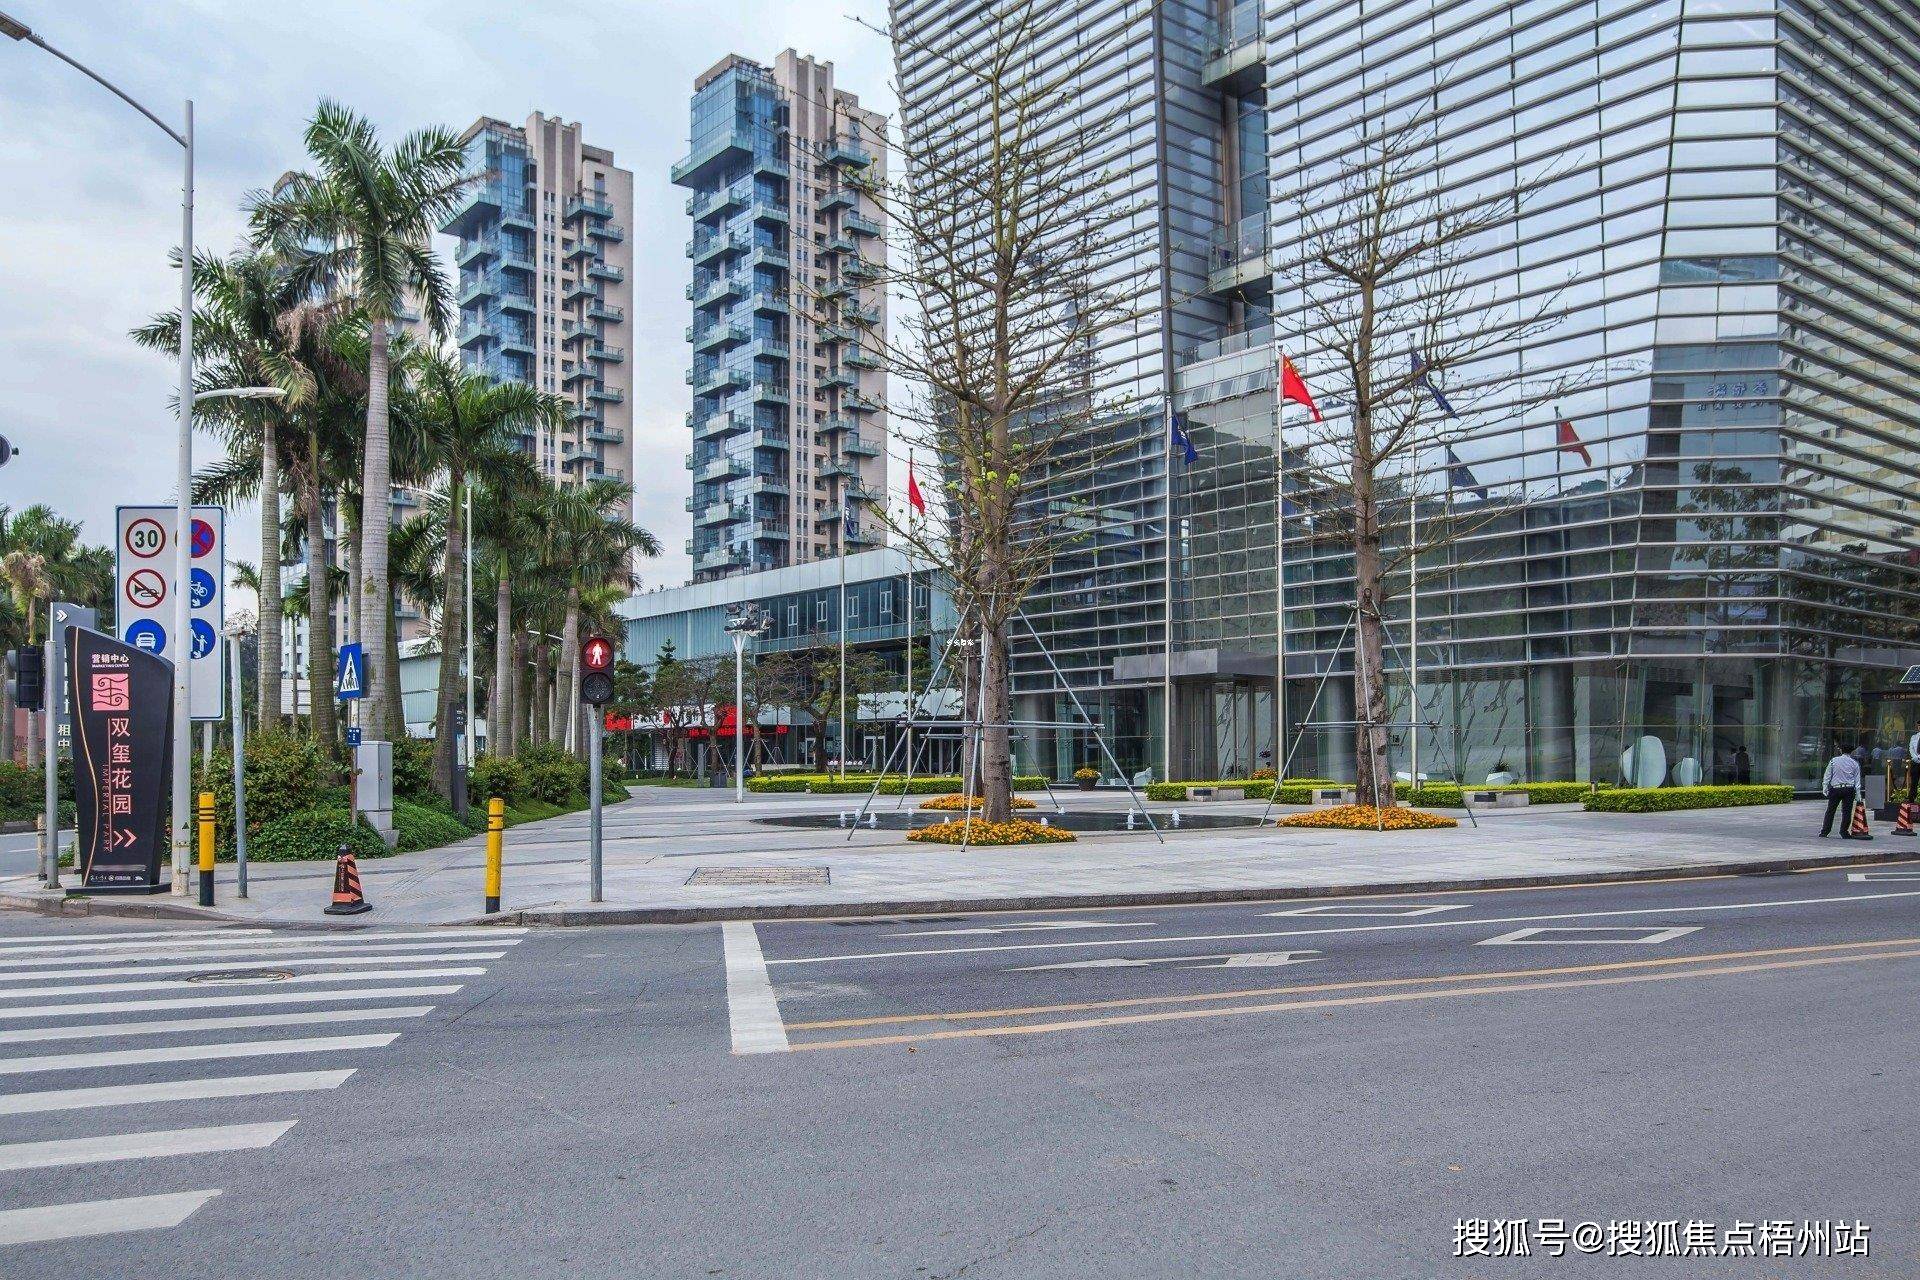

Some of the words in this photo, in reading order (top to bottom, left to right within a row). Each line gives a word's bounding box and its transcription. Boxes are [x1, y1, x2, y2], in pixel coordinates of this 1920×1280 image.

[134, 529, 158, 548] 30
[92, 654, 129, 663] 营销中心
[111, 718, 132, 815] 双玺花园
[102, 764, 110, 816] IMPERIAL
[103, 823, 111, 852] PARK
